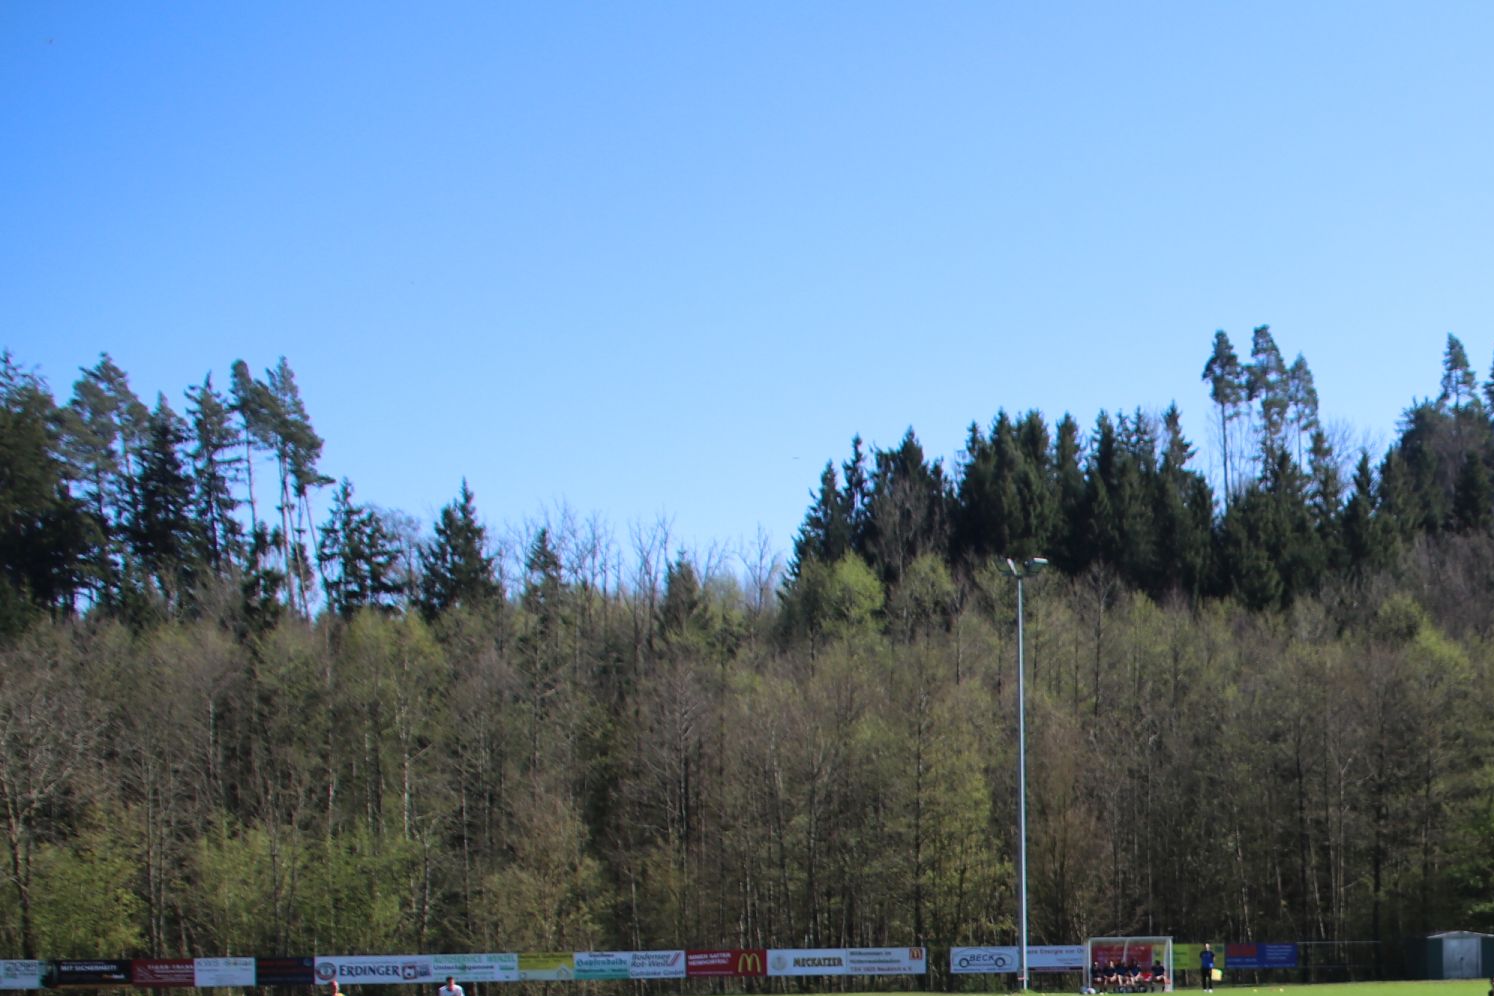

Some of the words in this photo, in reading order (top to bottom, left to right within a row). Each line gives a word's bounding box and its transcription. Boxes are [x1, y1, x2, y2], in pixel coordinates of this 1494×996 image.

[632, 952, 670, 960] Bodensee
[969, 953, 994, 961] BECK
[793, 957, 843, 967] MECKATZER
[339, 965, 400, 977] ERDINGER
